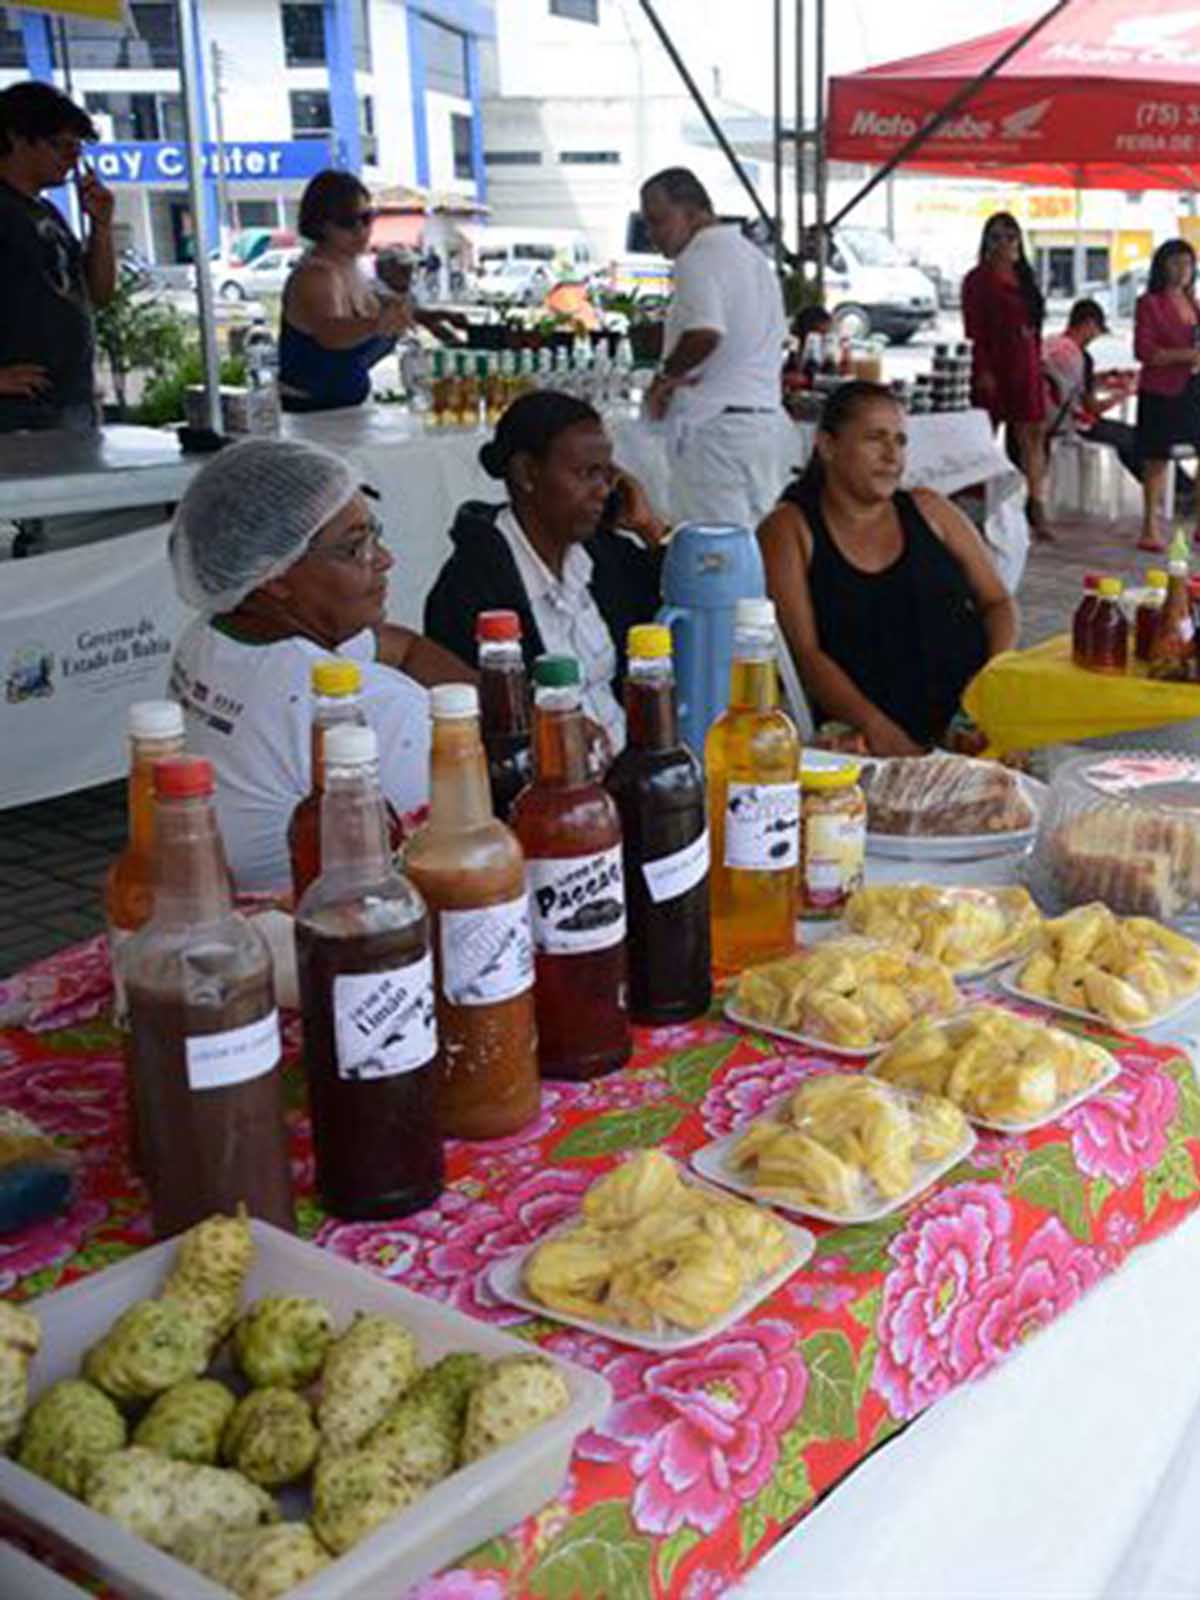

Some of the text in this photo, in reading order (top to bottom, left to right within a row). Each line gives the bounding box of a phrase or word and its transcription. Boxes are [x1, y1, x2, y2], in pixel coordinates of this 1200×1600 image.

[850, 109, 917, 137] Moto
[1115, 133, 1166, 151] FEIRA
[1170, 133, 1194, 150] DE
[156, 146, 282, 176] Cnter
[76, 617, 155, 651] Governo do
[61, 636, 171, 677] Estado da Bahia
